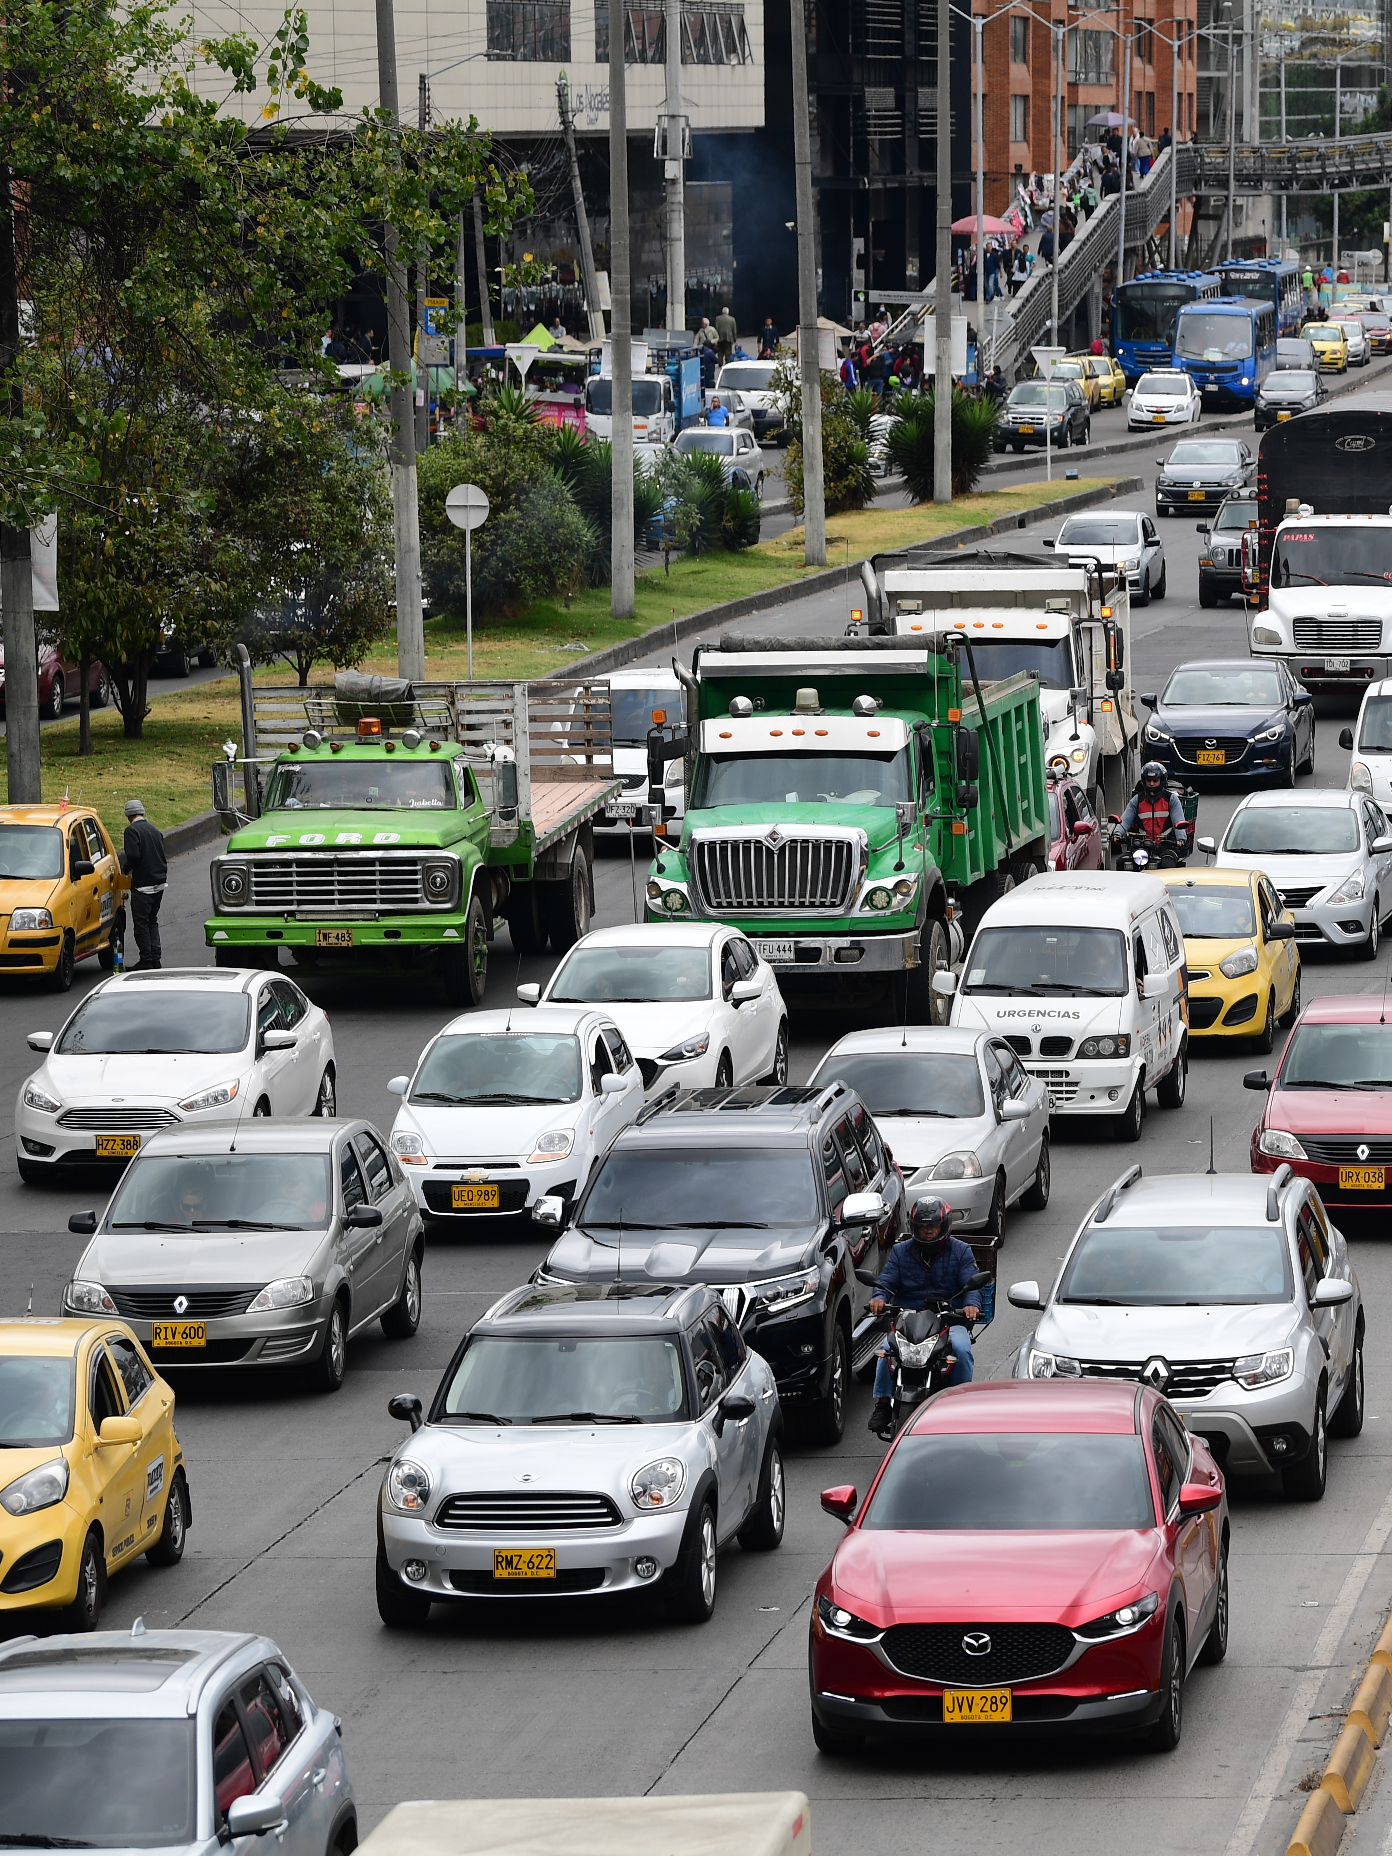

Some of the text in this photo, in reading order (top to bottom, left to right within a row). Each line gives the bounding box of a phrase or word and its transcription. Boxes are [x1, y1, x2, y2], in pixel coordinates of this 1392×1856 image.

[1283, 533, 1315, 541] PAPAS
[265, 832, 402, 848] FORD
[996, 1009, 1081, 1019] URGENCIAS
